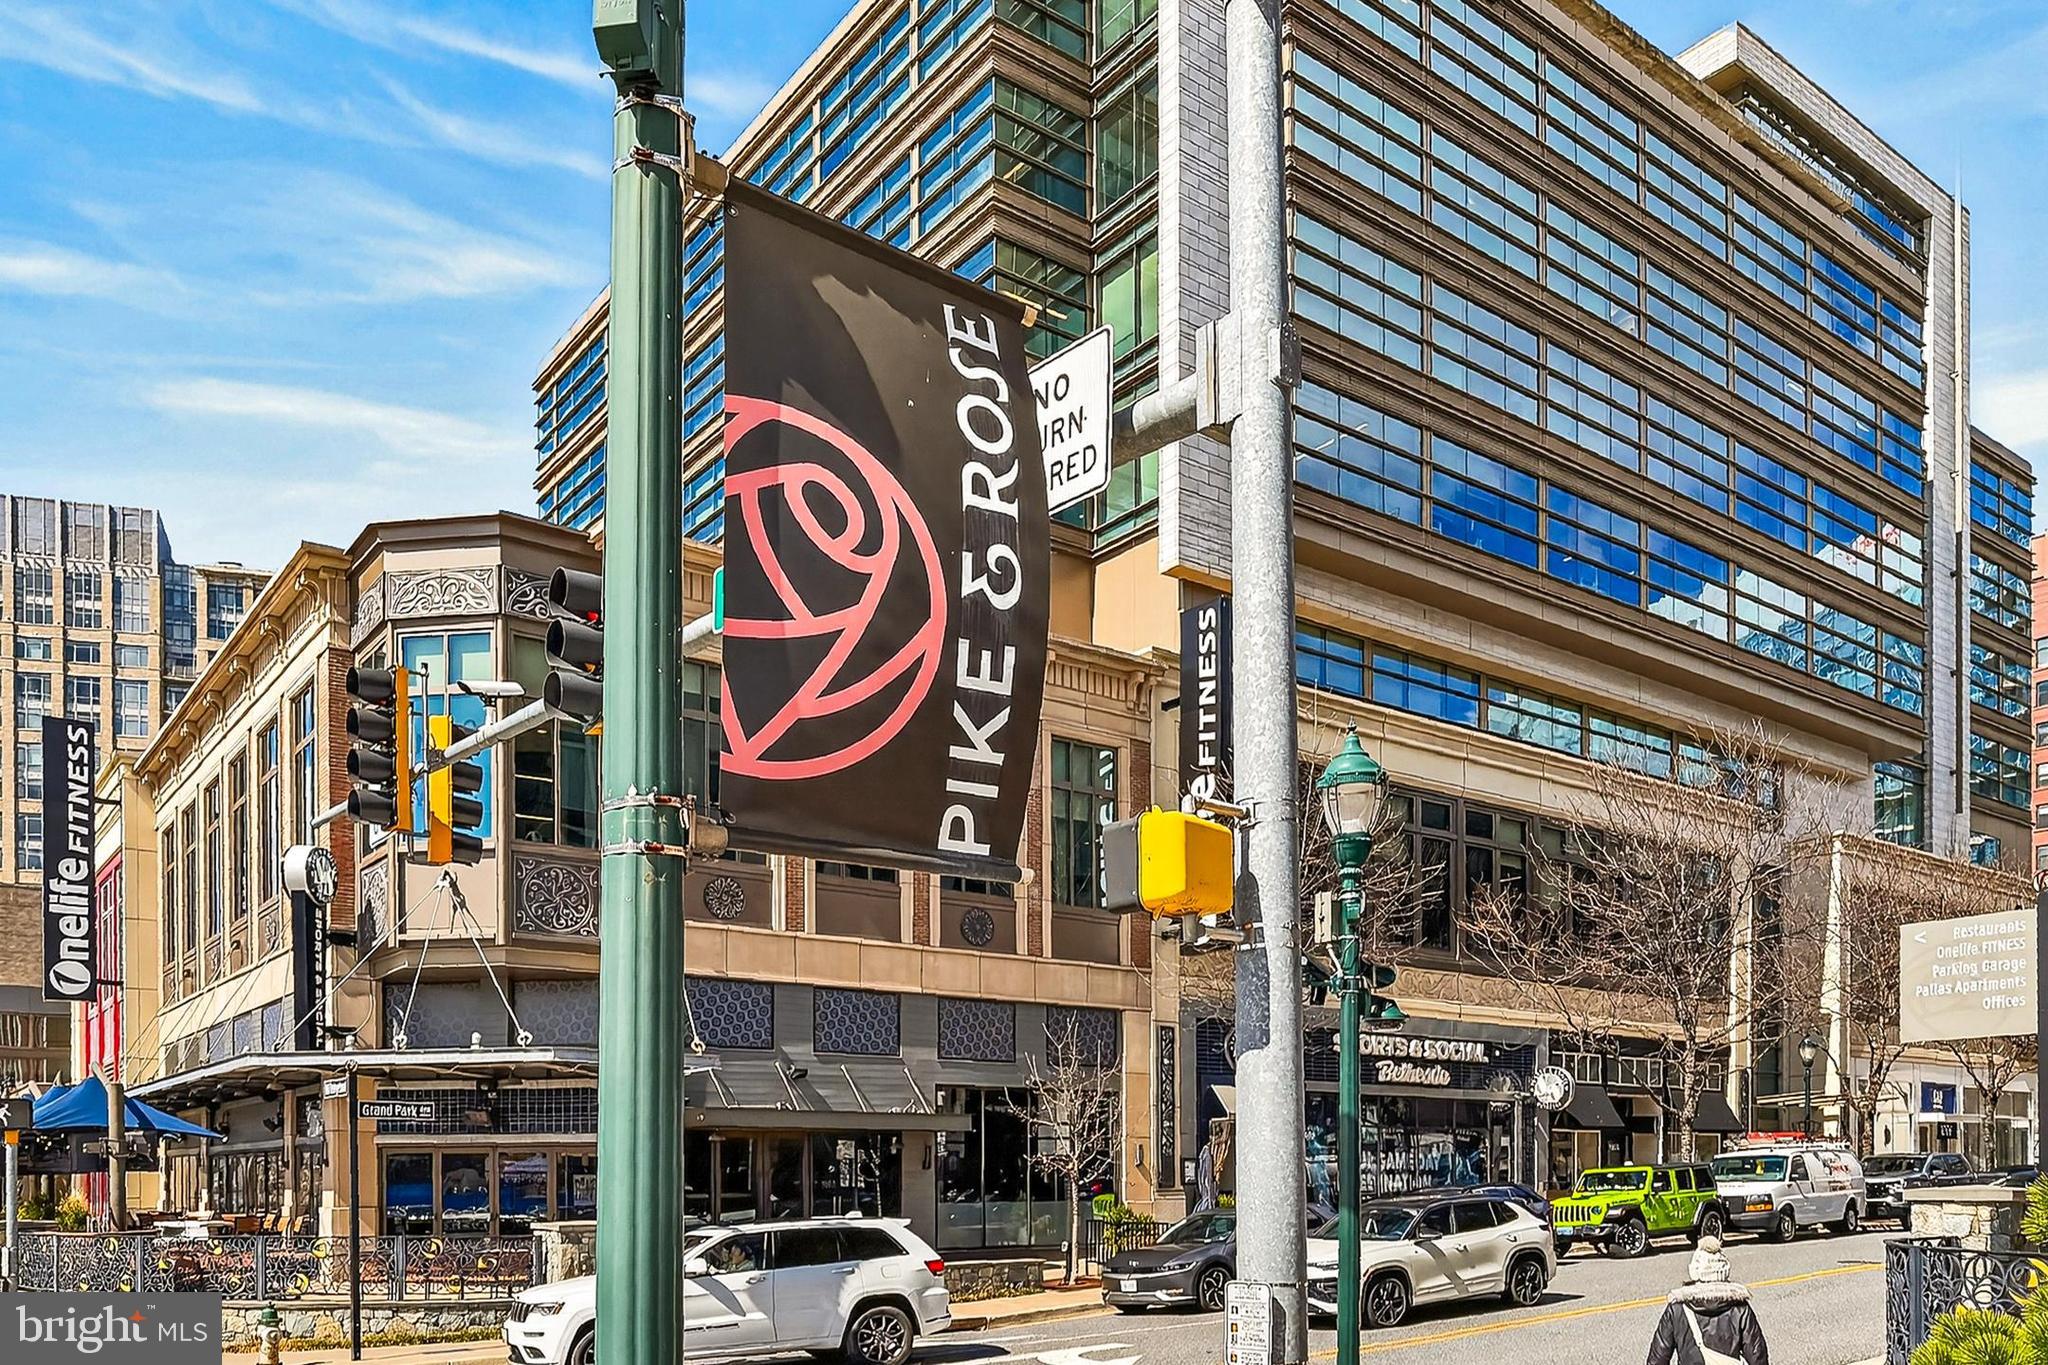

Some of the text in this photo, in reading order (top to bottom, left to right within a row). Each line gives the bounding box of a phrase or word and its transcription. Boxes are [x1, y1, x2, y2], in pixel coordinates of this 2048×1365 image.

[1034, 373, 1070, 410] NO
[1042, 406, 1084, 452] RN
[1050, 444, 1097, 491] RED
[937, 304, 1022, 857] PIKE & ROSE
[1198, 606, 1217, 767] FITNESS
[48, 724, 92, 996] Onelife FITNESS
[1953, 920, 2027, 939] Restaurants
[1937, 937, 2026, 959] Onelife FITNESS
[1932, 958, 2026, 978] Parking Garage
[1955, 976, 2027, 995] Apartments
[1983, 996, 2026, 1010] Offices
[1333, 1033, 1408, 1056] SORTS
[362, 1104, 393, 1116] Grand
[395, 1104, 417, 1117] Park
